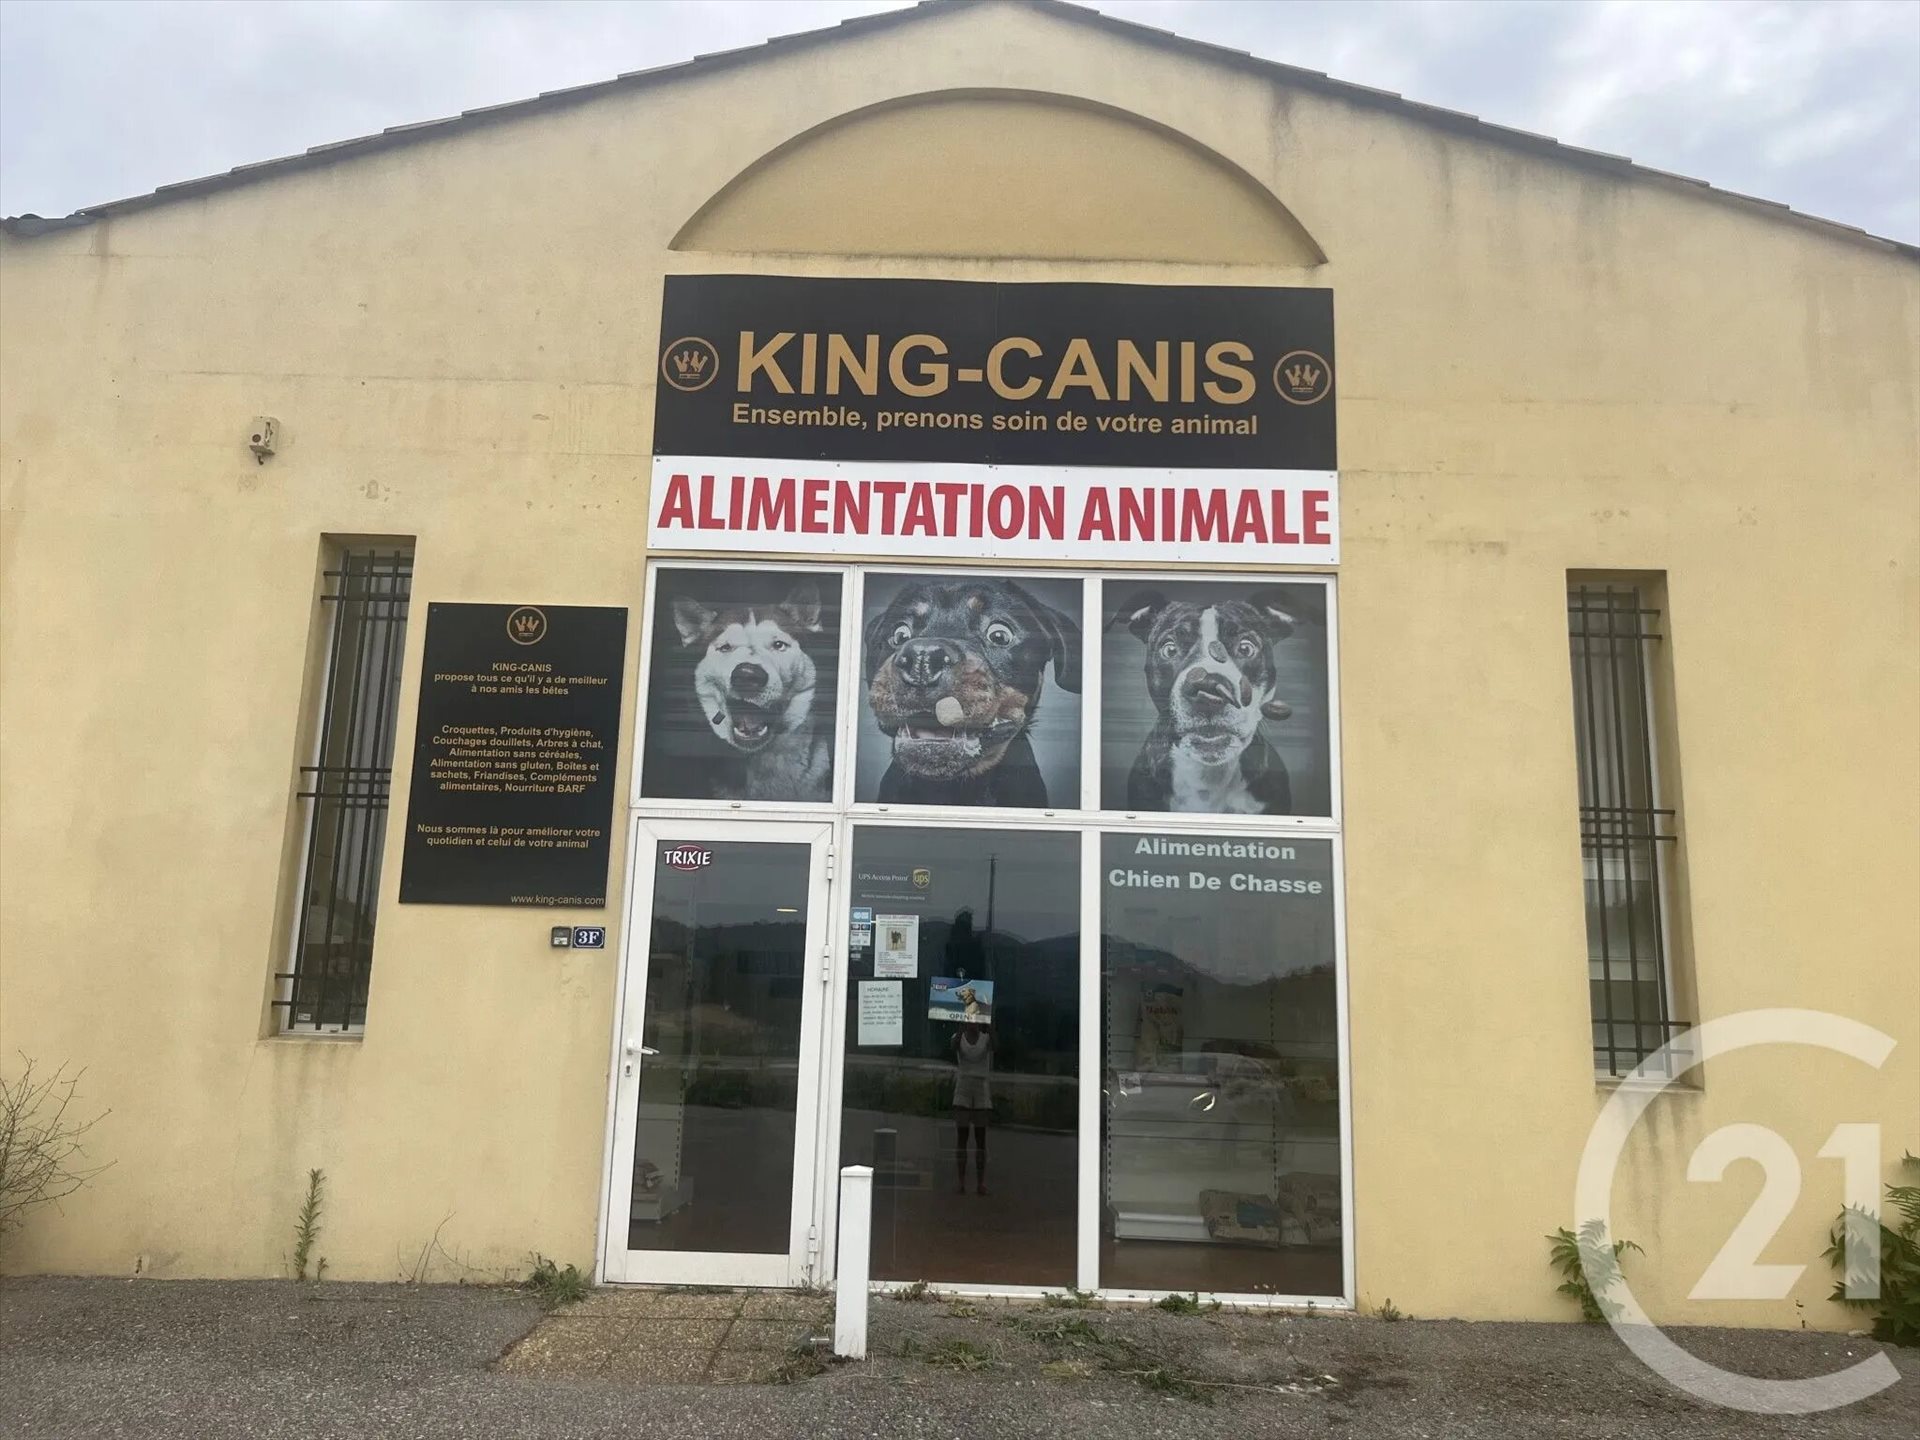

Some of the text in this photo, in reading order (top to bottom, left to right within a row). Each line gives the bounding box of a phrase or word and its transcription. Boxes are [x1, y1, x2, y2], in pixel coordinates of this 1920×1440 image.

[737, 330, 1257, 404] KING-CANIS
[732, 403, 1258, 436] Ensemble, prenons soin de votre animal
[656, 474, 1331, 545] ALIMENTATION ANIMALE
[492, 662, 552, 672] KING-CANIS
[434, 673, 474, 683] propose
[477, 674, 498, 682] tous
[515, 675, 535, 685] qu'il
[537, 676, 543, 685] y
[546, 676, 552, 684] a
[554, 676, 566, 684] de
[569, 676, 608, 685] meilleur
[471, 684, 477, 692] à
[500, 685, 523, 694] amis
[526, 686, 540, 694] les
[543, 686, 569, 695] bêtes
[442, 725, 594, 738] Croquettes, Produits d'hygiène,
[432, 736, 604, 749] Couchages douillets, Arbres à chat,
[450, 748, 510, 758] Alimentation
[539, 750, 582, 760] céréales,
[430, 759, 600, 771] Alimentation sans gluten, Boîtes et
[430, 770, 597, 783] sachets, Friandises, Compléments
[440, 782, 586, 793] alimentaires, Nourriture BARF
[417, 824, 443, 833] Nous
[490, 826, 498, 835] là
[501, 827, 523, 837] pour
[526, 827, 572, 836] améliorer
[575, 829, 600, 837] votre
[427, 837, 589, 848] quotidien et celui de votre animal
[1134, 838, 1296, 860] Alimentation
[663, 850, 712, 865] TRIXIE
[1109, 869, 1322, 894] Chien De Chasse
[511, 895, 604, 905] www.king-canis.com
[578, 931, 600, 944] 3F
